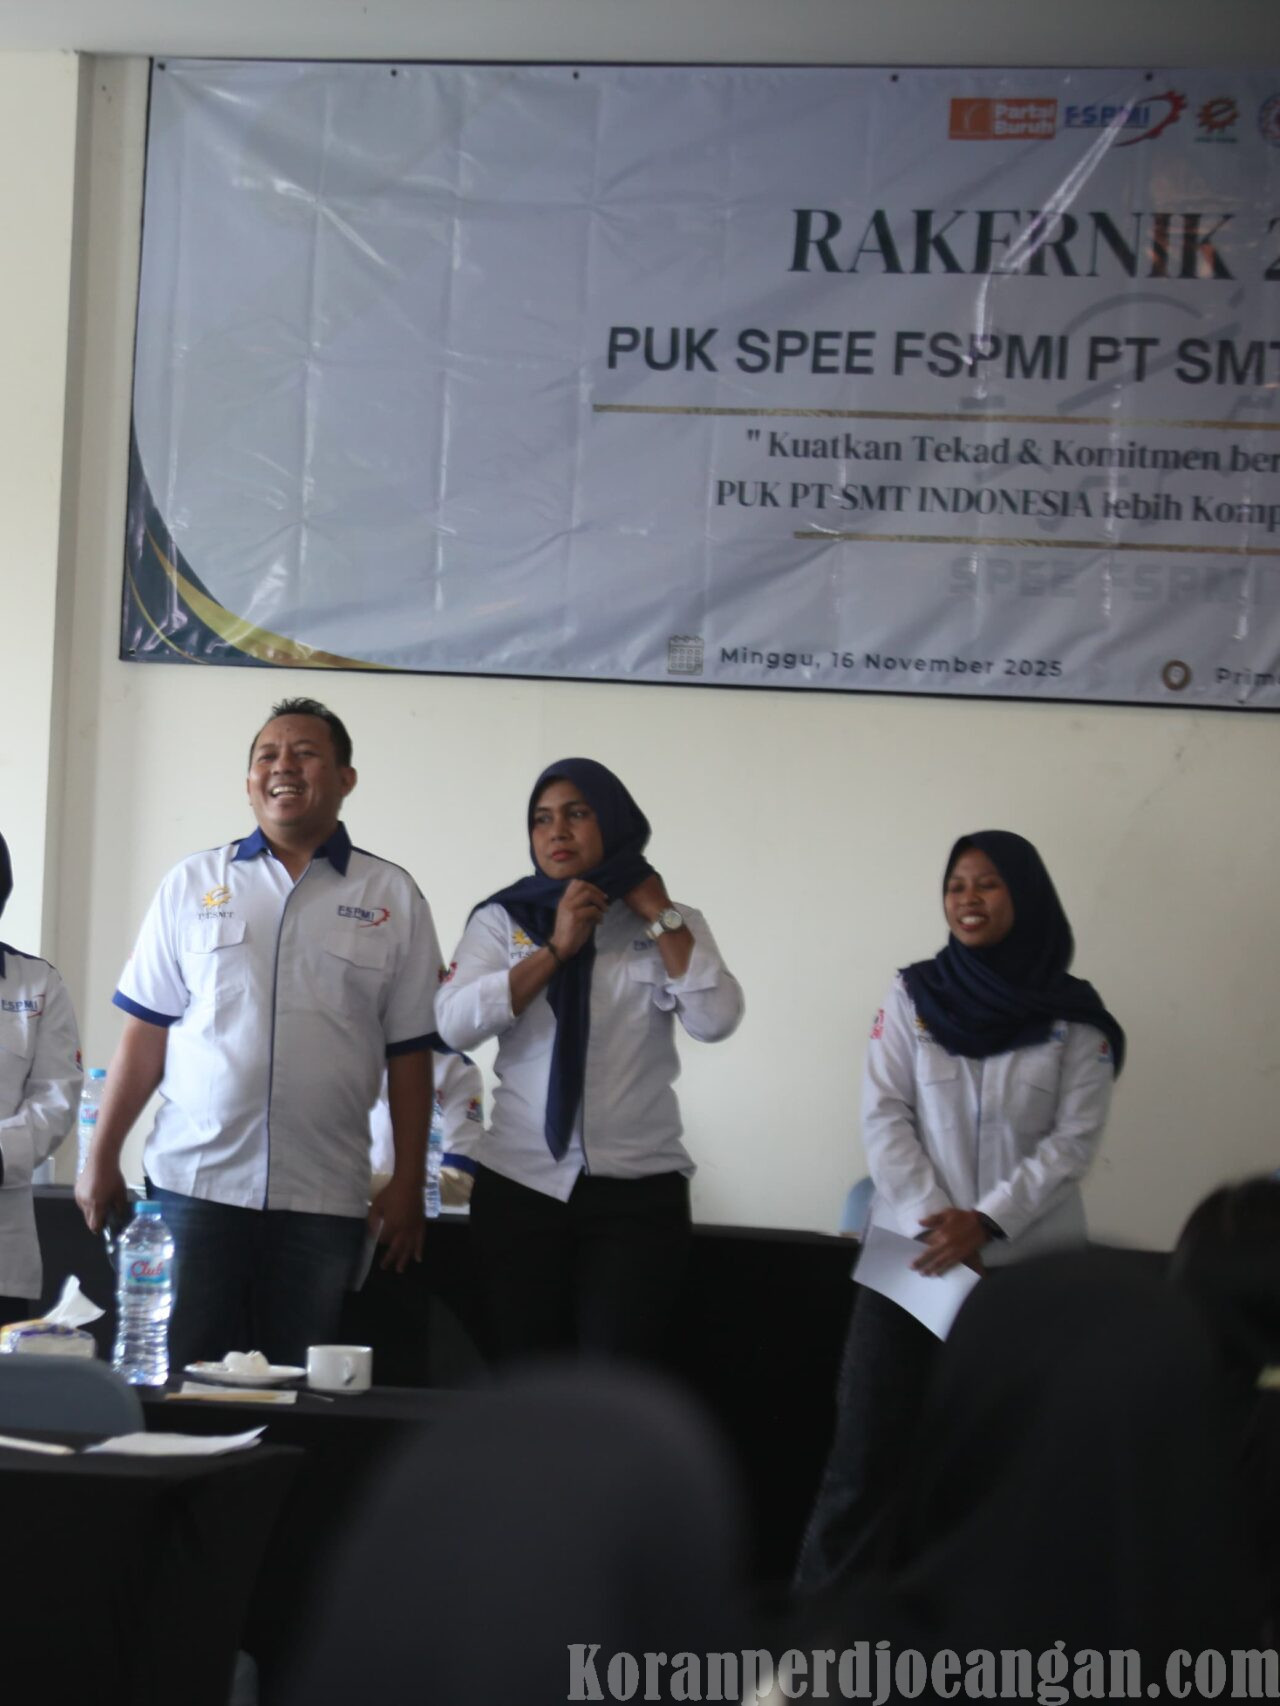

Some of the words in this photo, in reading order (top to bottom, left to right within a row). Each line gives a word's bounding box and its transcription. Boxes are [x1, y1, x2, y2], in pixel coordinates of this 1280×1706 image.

[1065, 105, 1150, 128] FSPMI
[787, 209, 1237, 280] RAKERNIK
[607, 326, 719, 372] PUK
[736, 328, 876, 375] SPEE
[893, 331, 1068, 380] FSPMI
[1087, 336, 1160, 382] PT
[912, 436, 1010, 464] Tekad
[1017, 438, 1043, 466] &
[1053, 440, 1221, 471] Komitmen
[716, 480, 781, 508] PUK
[790, 483, 833, 508] PT
[840, 484, 910, 512] SMT
[918, 487, 1092, 518] INDONESIA
[1103, 492, 1182, 521] lebih
[720, 648, 820, 669] Minggu,
[831, 652, 855, 669] 16
[865, 654, 993, 676] November
[1004, 658, 1063, 678] 2025
[1216, 668, 1280, 687] Prim
[131, 1260, 163, 1278] Club
